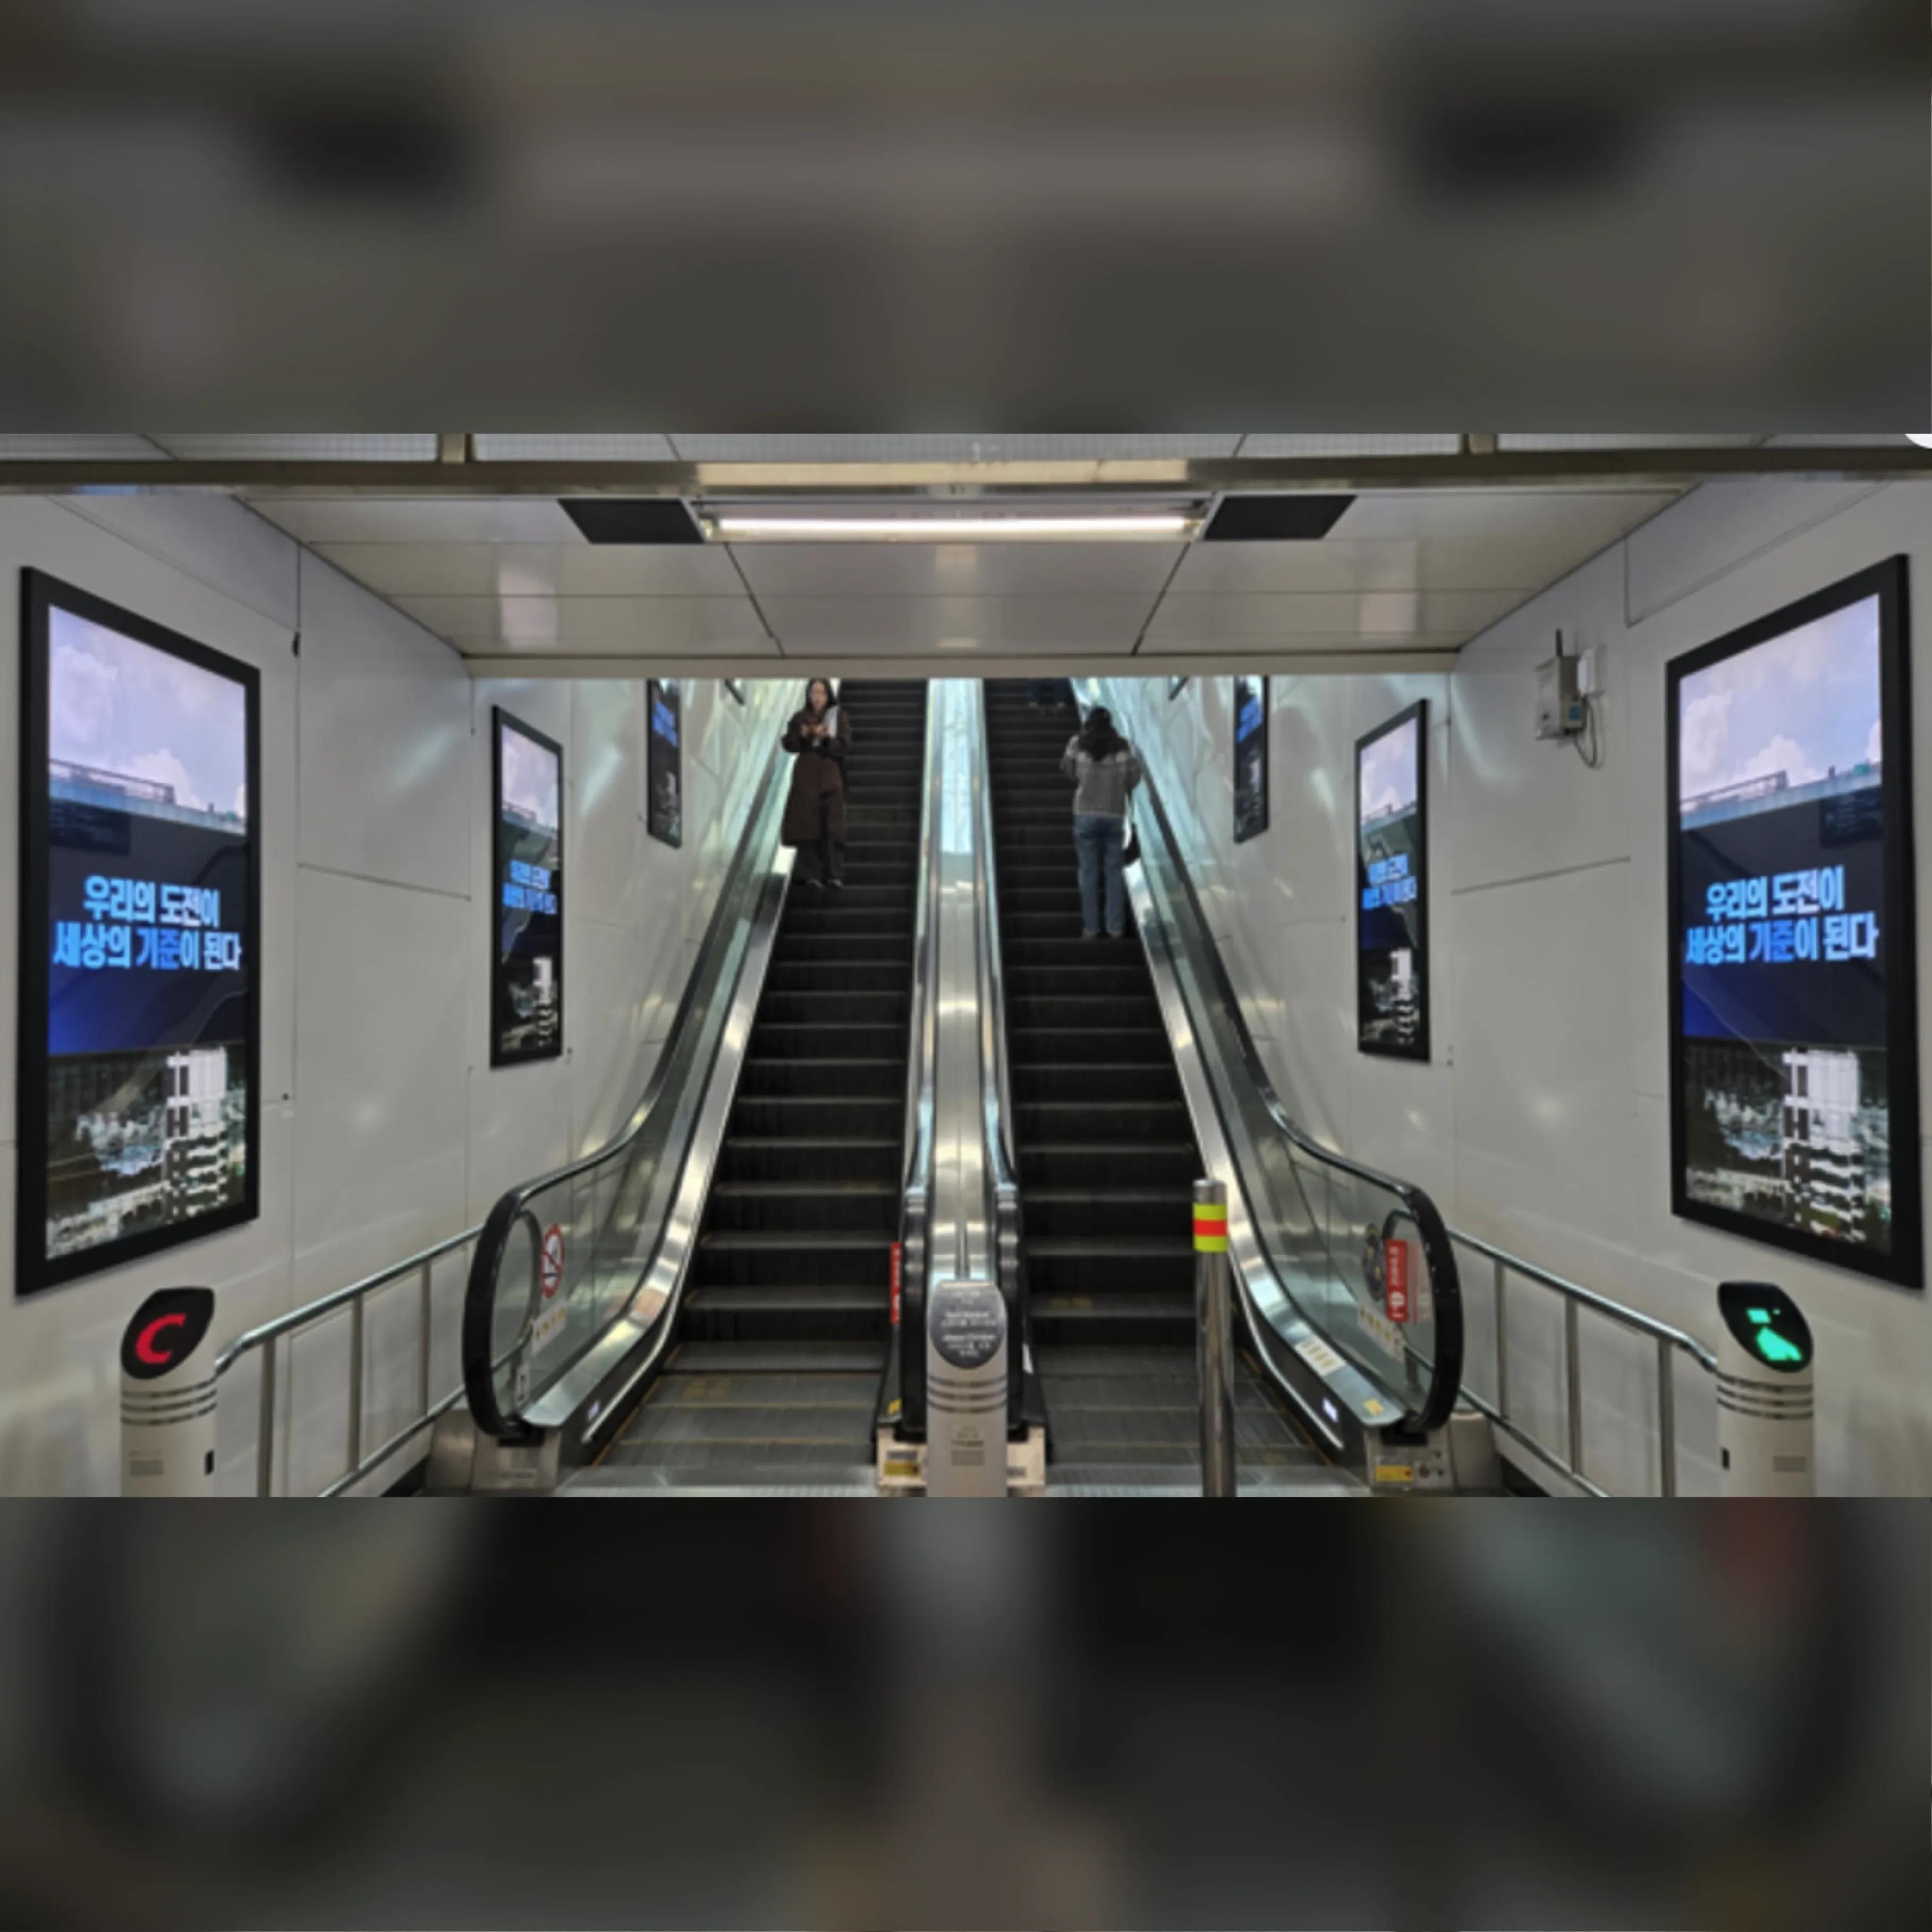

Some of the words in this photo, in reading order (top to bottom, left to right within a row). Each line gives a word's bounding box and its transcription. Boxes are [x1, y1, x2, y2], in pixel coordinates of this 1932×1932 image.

[83, 875, 155, 922] 우리의
[160, 884, 220, 928] 도전이
[1706, 877, 1767, 922] 우리의
[1773, 864, 1844, 914] 도전이
[53, 922, 131, 969] 세상의
[136, 927, 199, 970] 기준이
[204, 931, 242, 970] 된다
[1685, 923, 1745, 965] 세상의
[1749, 917, 1818, 962] 기준이
[1823, 911, 1879, 961] 된다
